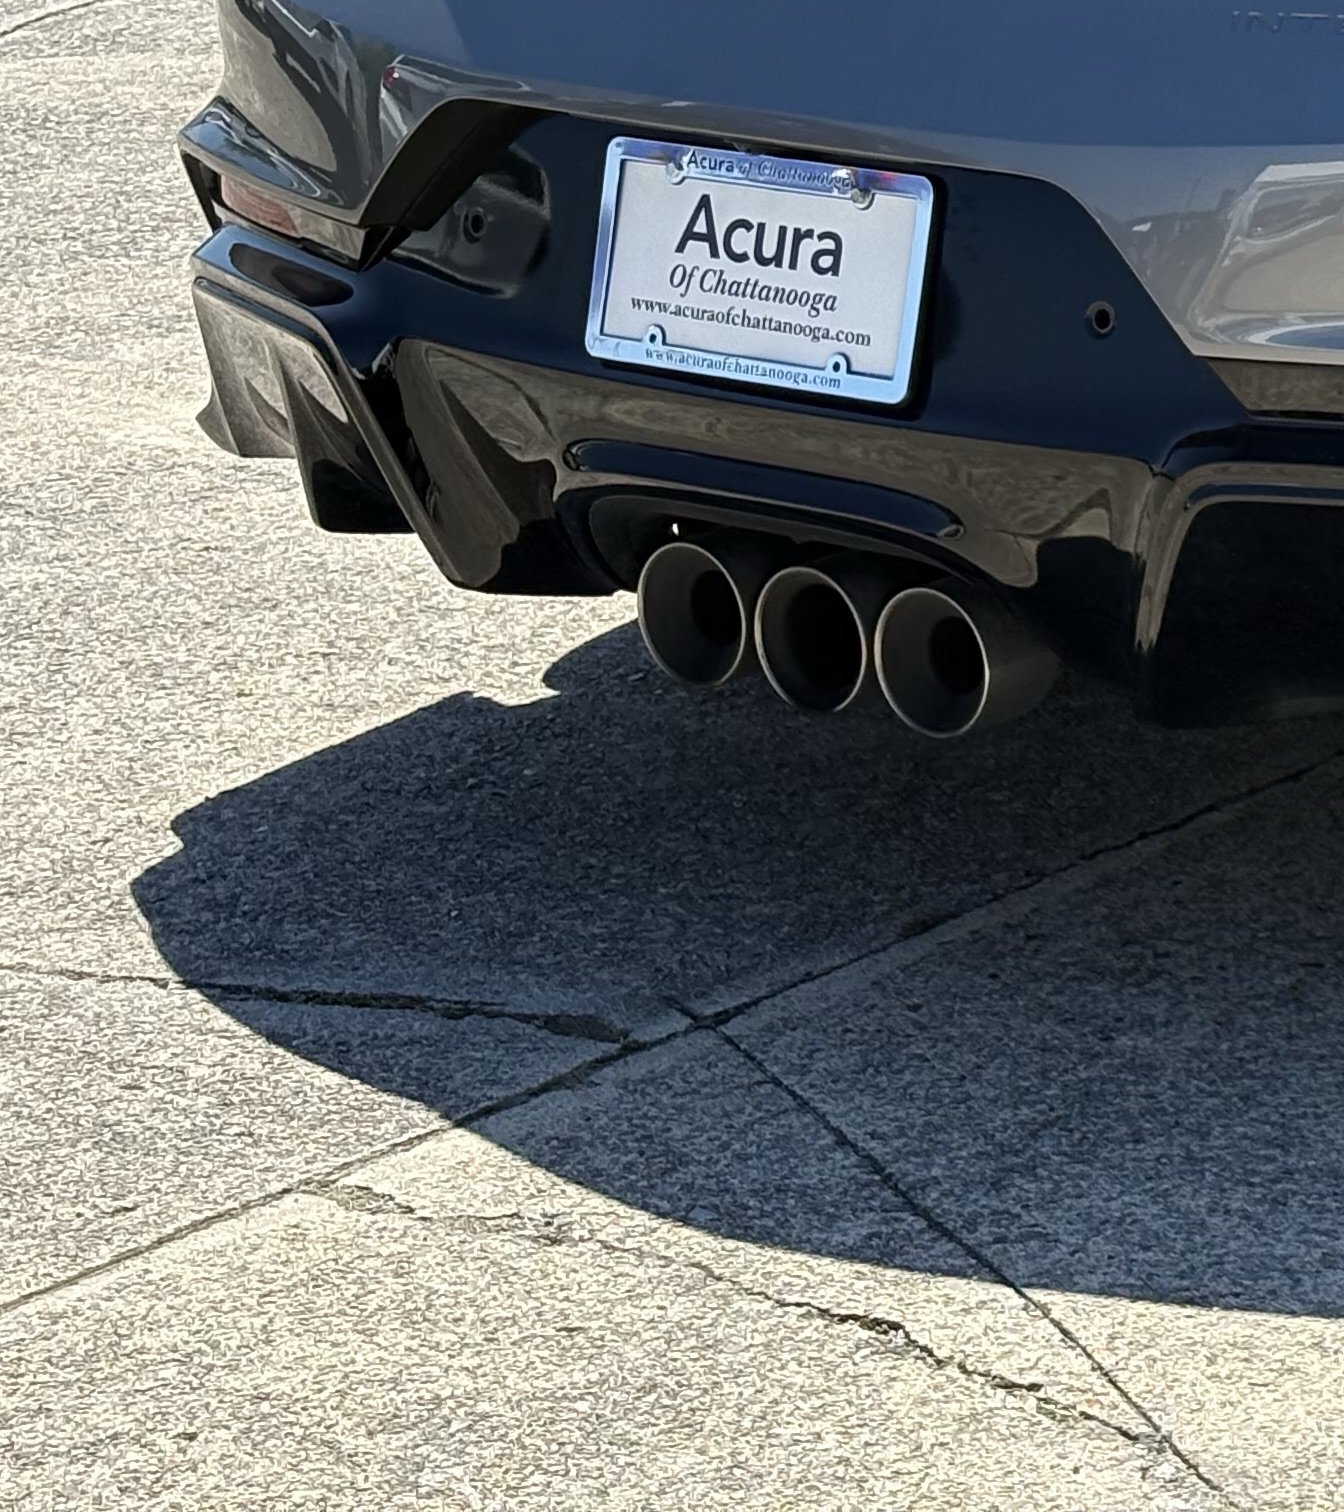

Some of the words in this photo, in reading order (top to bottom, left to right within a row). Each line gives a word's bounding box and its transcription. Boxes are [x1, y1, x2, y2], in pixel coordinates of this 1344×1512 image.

[686, 148, 735, 173] Acura
[739, 161, 752, 178] of
[674, 193, 844, 277] Acura
[669, 263, 699, 298] Of
[700, 267, 838, 318] Chattanooga
[631, 297, 872, 347] www.acuraofchattanooga.com
[645, 347, 841, 389] www.acuraofchattanooga.com
